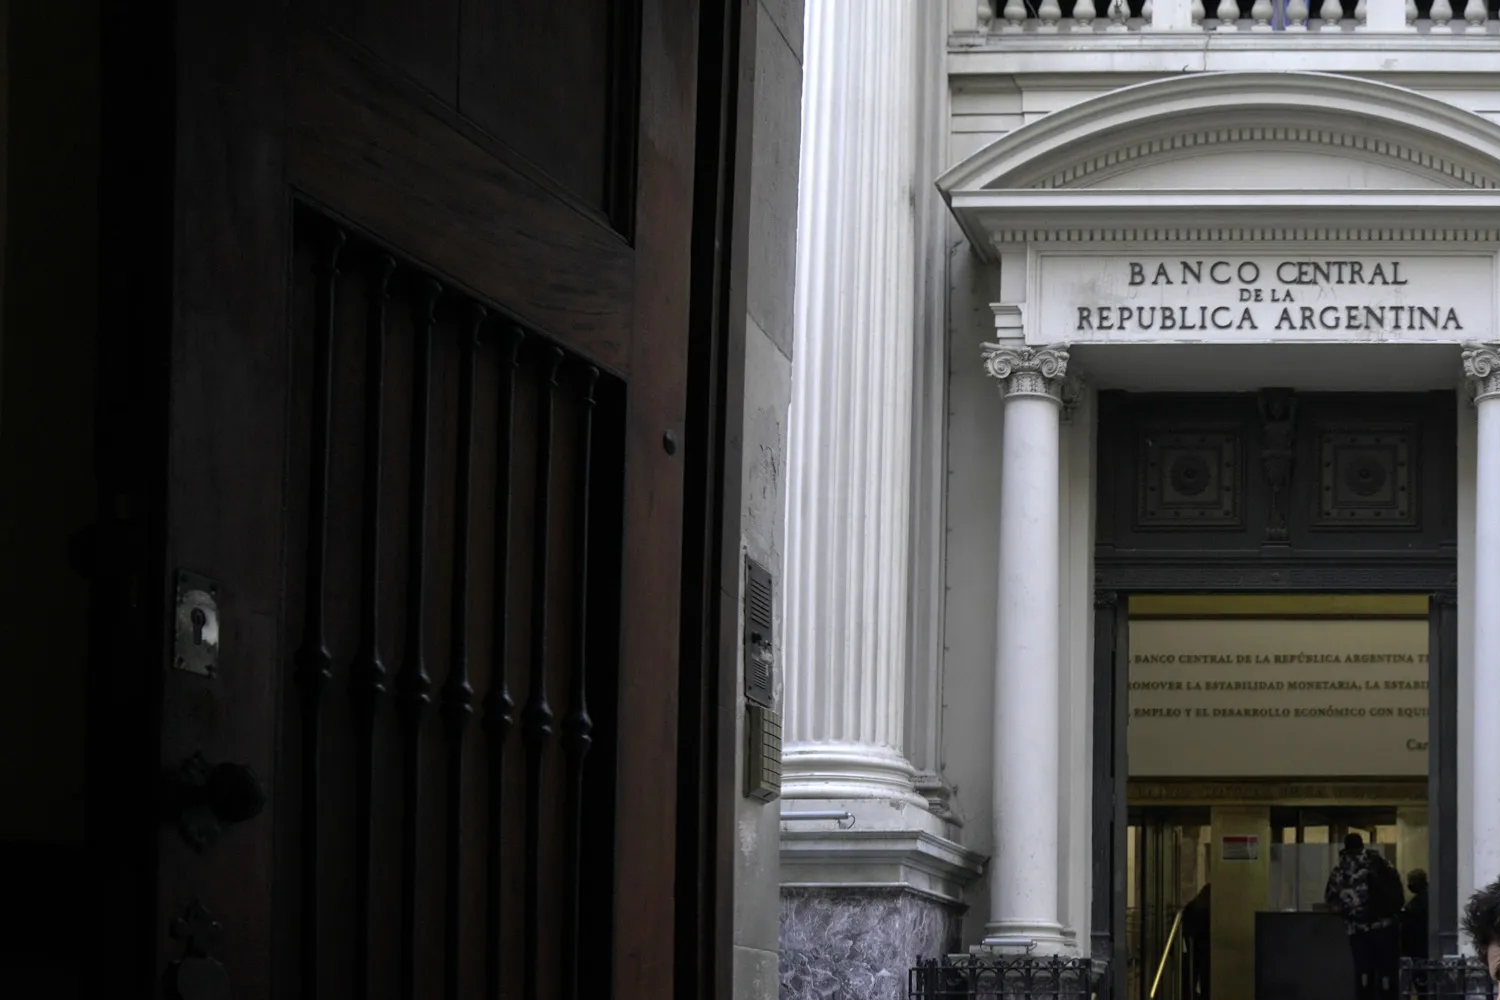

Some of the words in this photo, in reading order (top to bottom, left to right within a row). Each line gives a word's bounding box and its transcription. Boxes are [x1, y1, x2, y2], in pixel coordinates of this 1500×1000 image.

[1128, 260, 1261, 286] BANCO
[1276, 260, 1408, 286] CENTRAL
[1239, 288, 1264, 303] DE
[1270, 288, 1295, 303] LA
[1076, 305, 1258, 331] REPUBLICA
[1274, 305, 1463, 331] ARGENTINA
[1134, 653, 1176, 664] BANCO
[1178, 653, 1233, 664] CENTRAL
[1236, 653, 1252, 664] DE
[1255, 653, 1271, 664] LA
[1273, 651, 1342, 664] REPÚBLICA
[1344, 653, 1414, 664] ARGENTINA
[1186, 680, 1202, 691] LA
[1205, 680, 1284, 691] ESTABILIDAD
[1287, 680, 1362, 691] MONETARIA,
[1365, 680, 1381, 691] LA
[1134, 707, 1182, 718] EMPLEO
[1184, 707, 1192, 718] Y
[1195, 707, 1210, 718] EL
[1212, 707, 1291, 718] DESARROLLO
[1293, 704, 1366, 718] ECONÓMICO
[1369, 707, 1394, 718] CON
